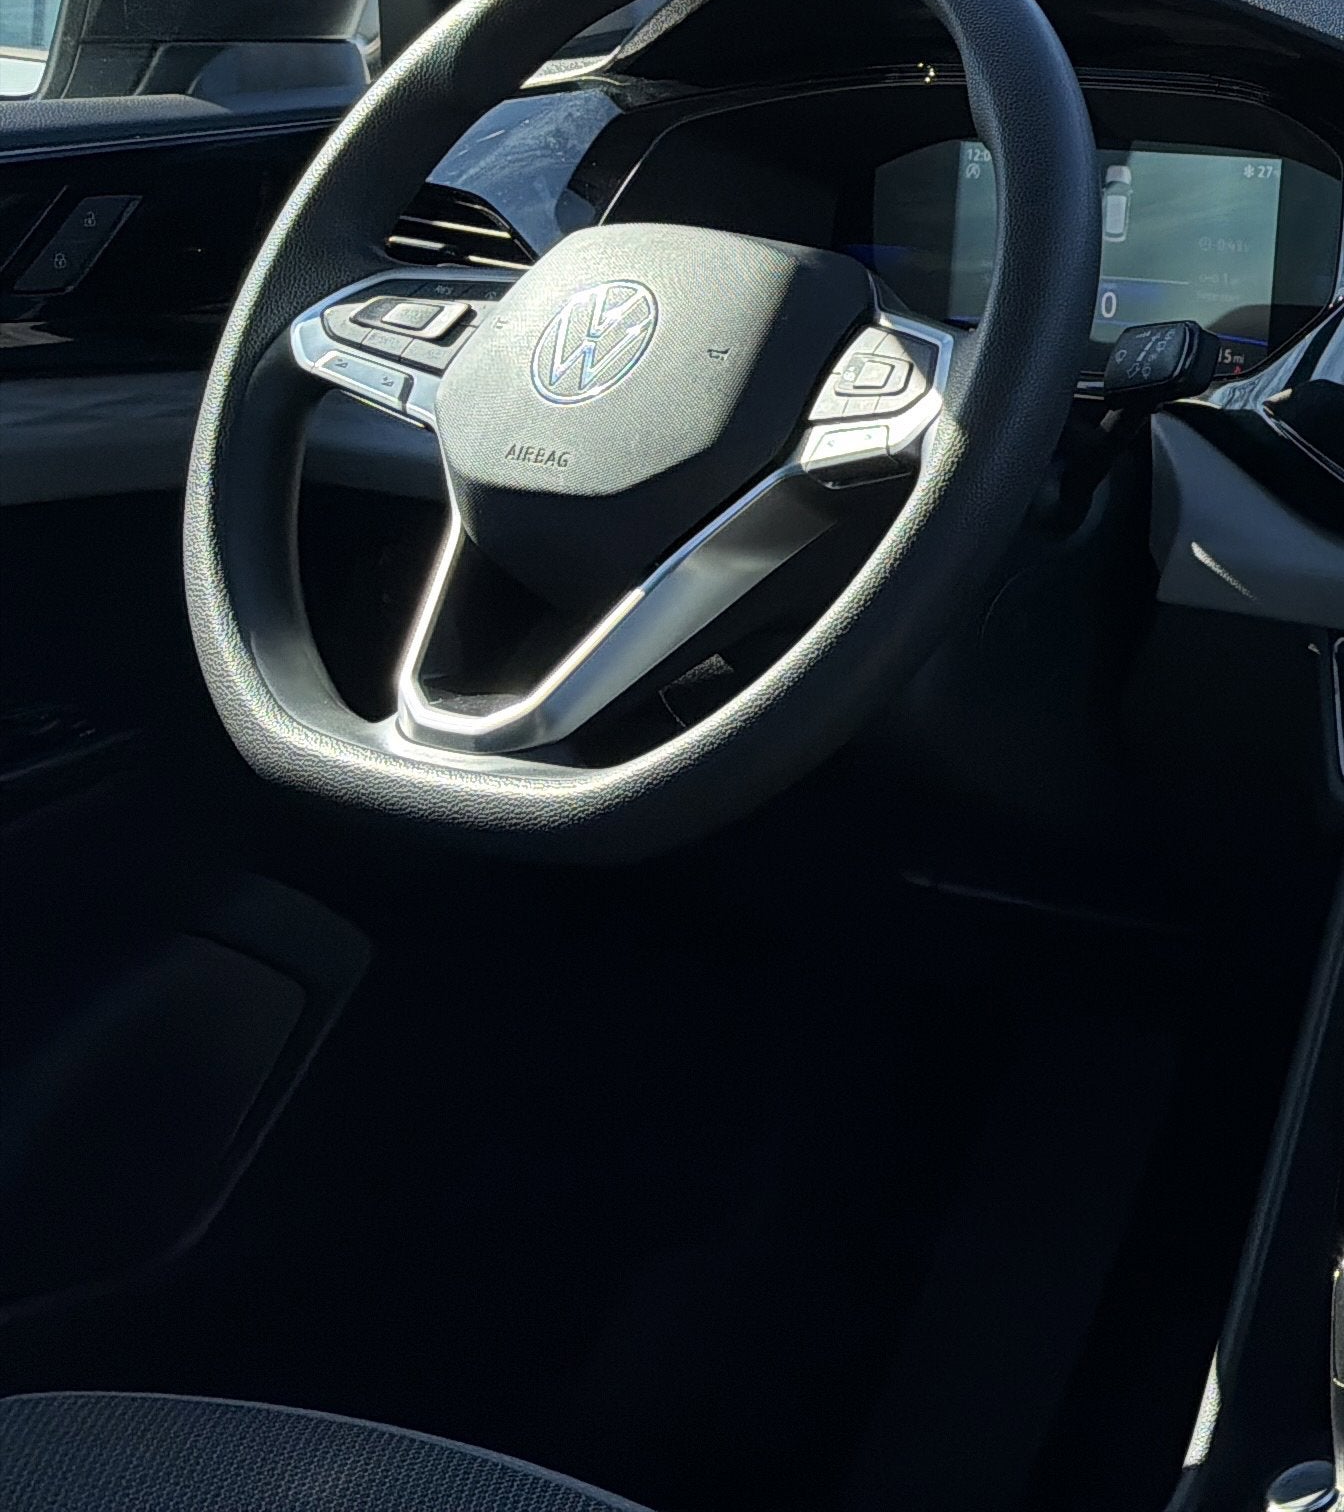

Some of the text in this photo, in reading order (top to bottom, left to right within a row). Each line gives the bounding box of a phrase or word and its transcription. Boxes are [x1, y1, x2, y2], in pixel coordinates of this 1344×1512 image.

[967, 149, 991, 161] 12:0
[1233, 354, 1245, 364] mi
[505, 443, 571, 468] AIRBAG
